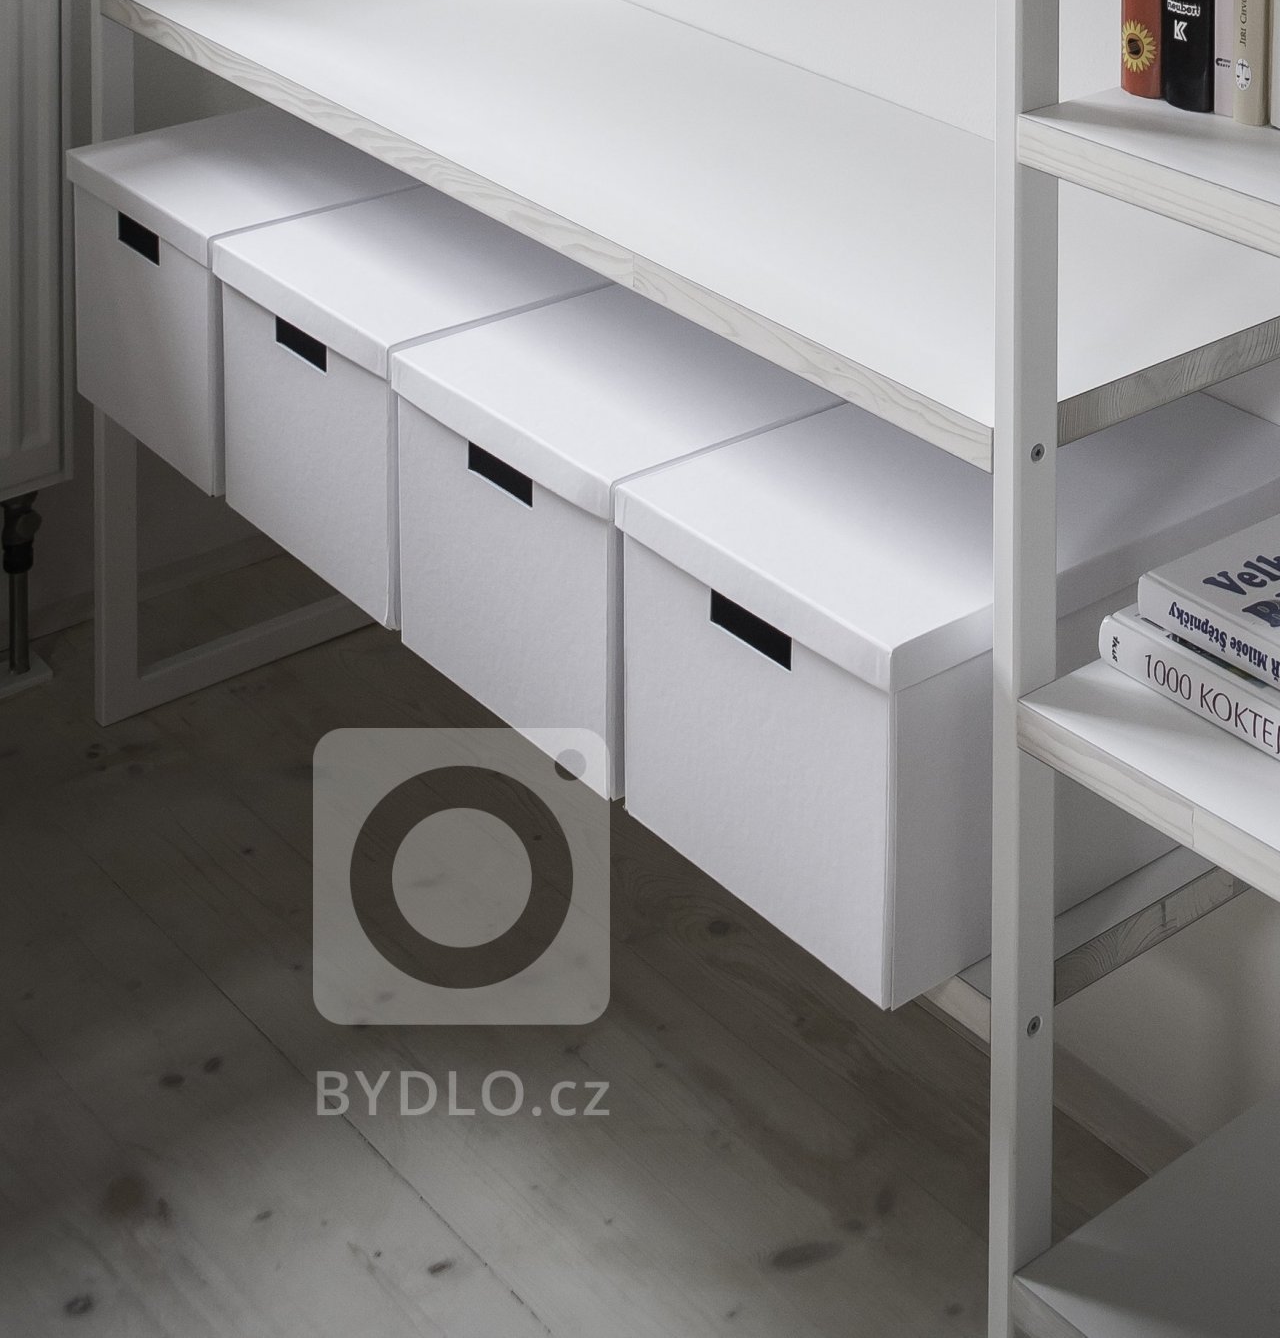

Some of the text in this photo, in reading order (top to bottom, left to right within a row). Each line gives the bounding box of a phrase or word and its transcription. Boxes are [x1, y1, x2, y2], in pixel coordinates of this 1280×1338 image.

[1167, 0, 1201, 16] neubert
[1166, 601, 1228, 653] Štěpničky
[1228, 635, 1268, 672] Miloše
[1144, 653, 1193, 701] 1000
